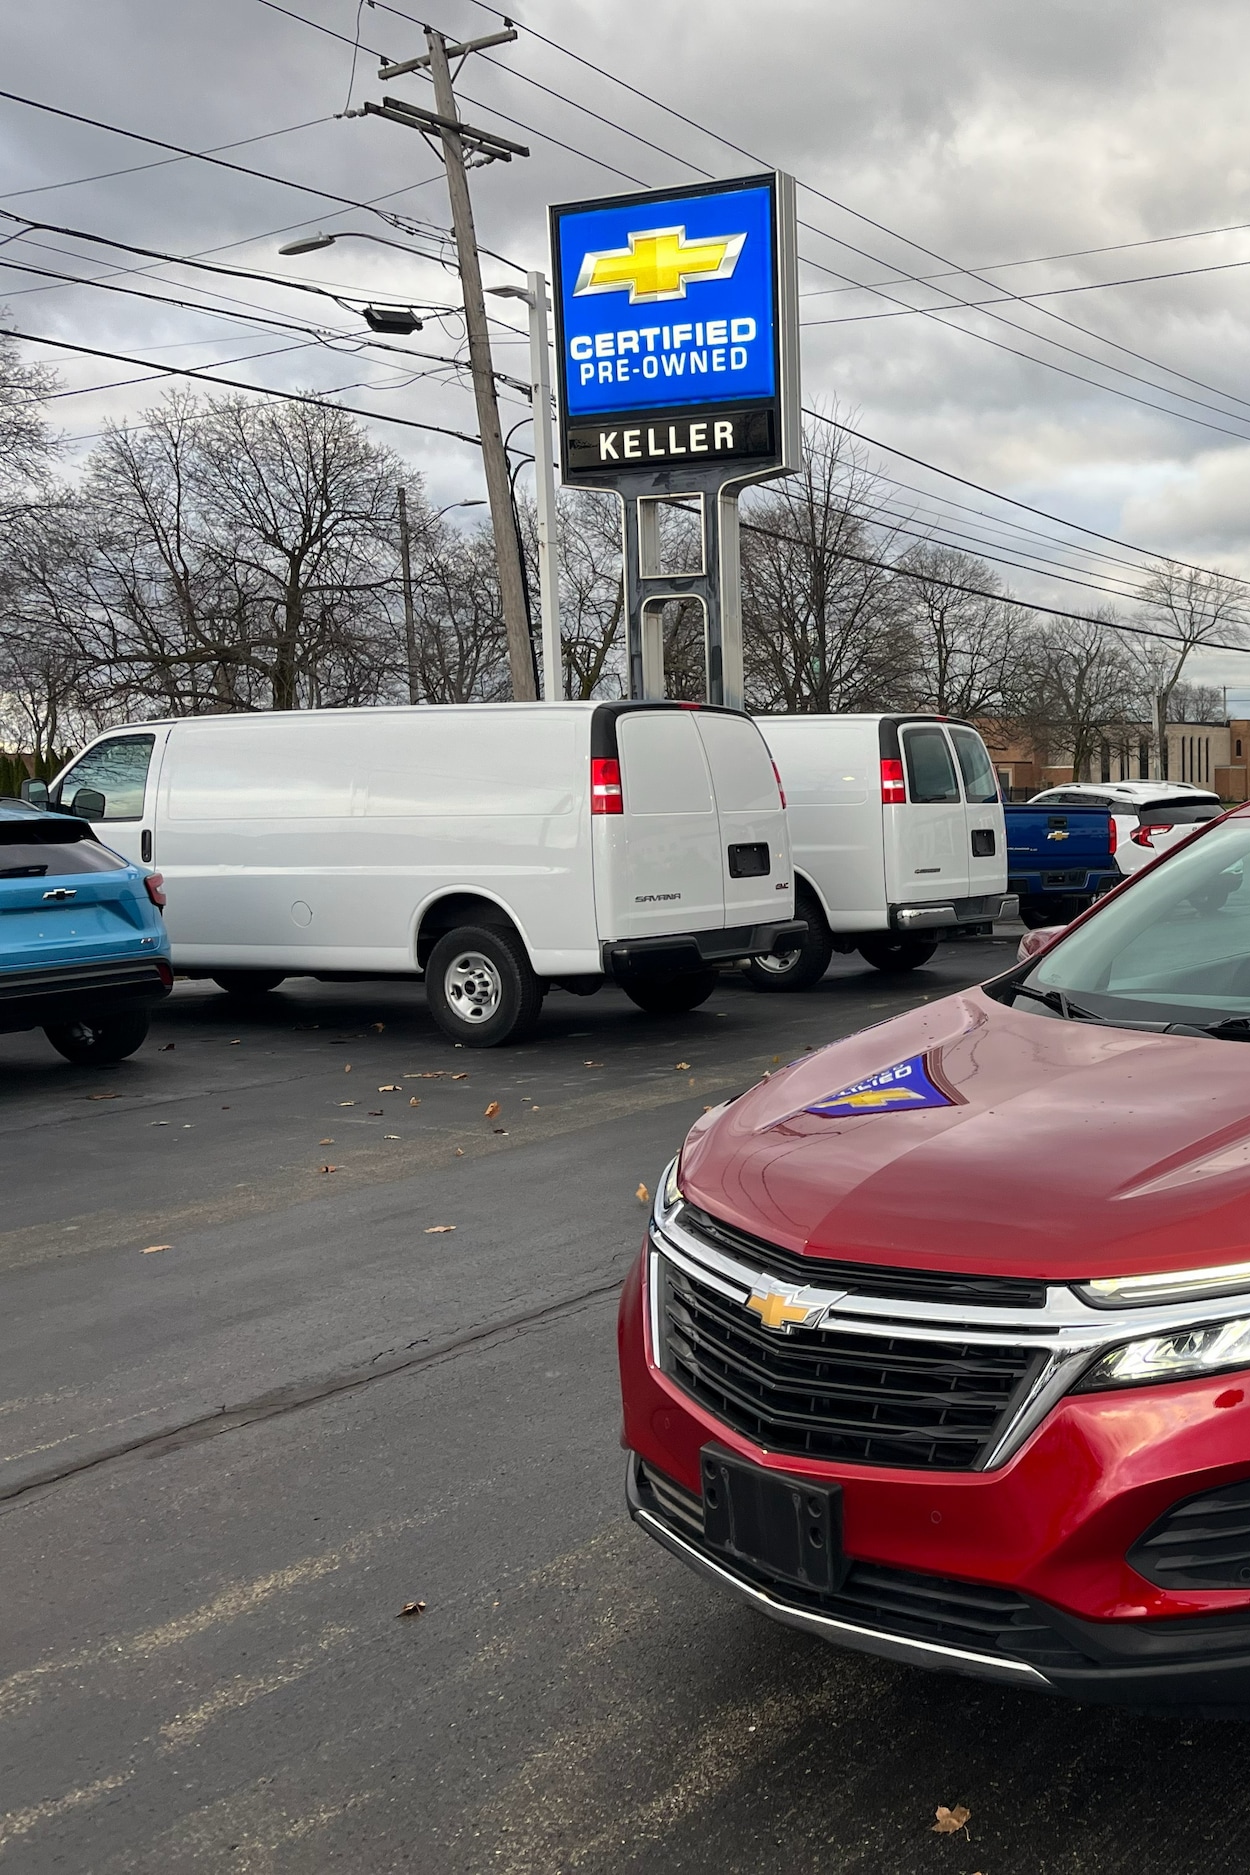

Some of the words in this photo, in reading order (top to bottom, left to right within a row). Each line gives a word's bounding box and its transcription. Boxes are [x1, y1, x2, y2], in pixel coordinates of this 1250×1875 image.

[570, 317, 757, 361] CERTIFIED
[580, 346, 748, 386] PRE-OWNED
[600, 421, 734, 461] KELLER
[634, 892, 681, 903] SAVANA
